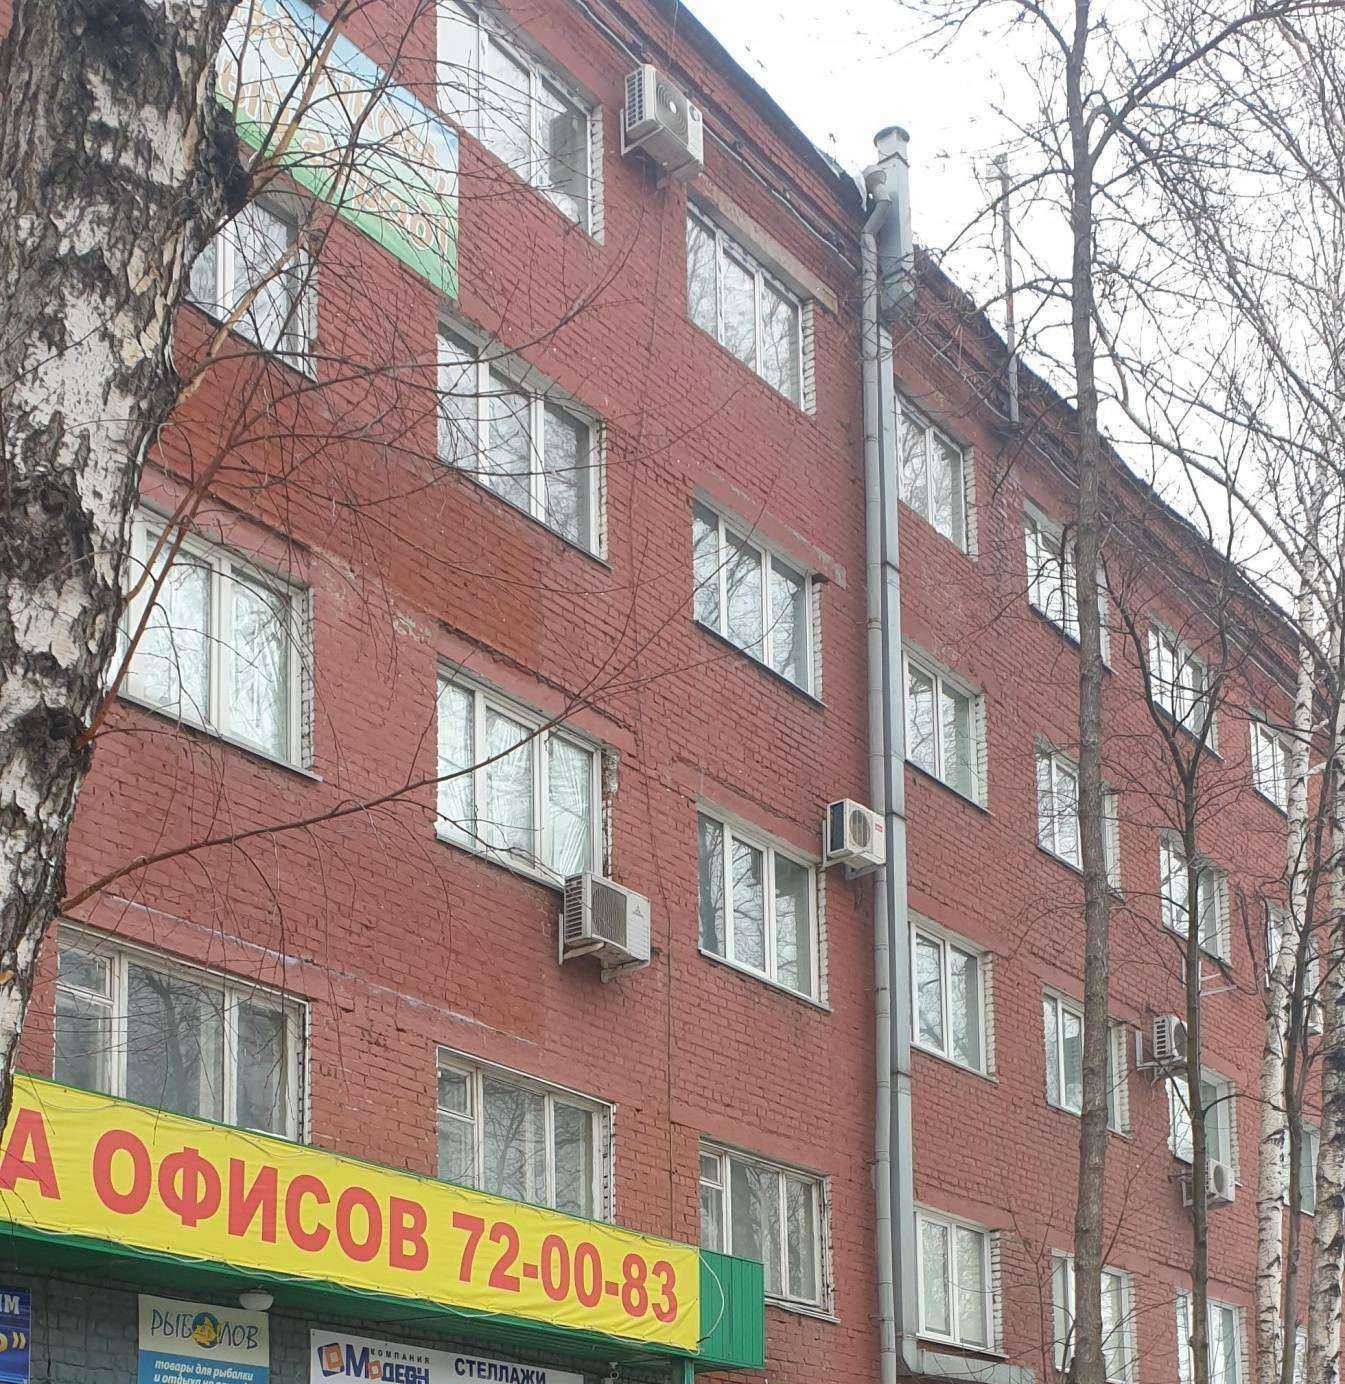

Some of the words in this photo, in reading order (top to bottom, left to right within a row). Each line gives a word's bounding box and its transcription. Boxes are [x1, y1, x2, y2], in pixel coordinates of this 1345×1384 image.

[92, 1128, 429, 1271] ОФИСОВ
[452, 1211, 678, 1323] 72-00-83
[151, 1308, 259, 1350] РЫБОЛОВ
[370, 1347, 430, 1364] КОМПАНИЯ
[153, 1374, 160, 1382] и
[155, 1360, 194, 1374] товары
[195, 1366, 212, 1376] для
[213, 1366, 254, 1381] рыбалки
